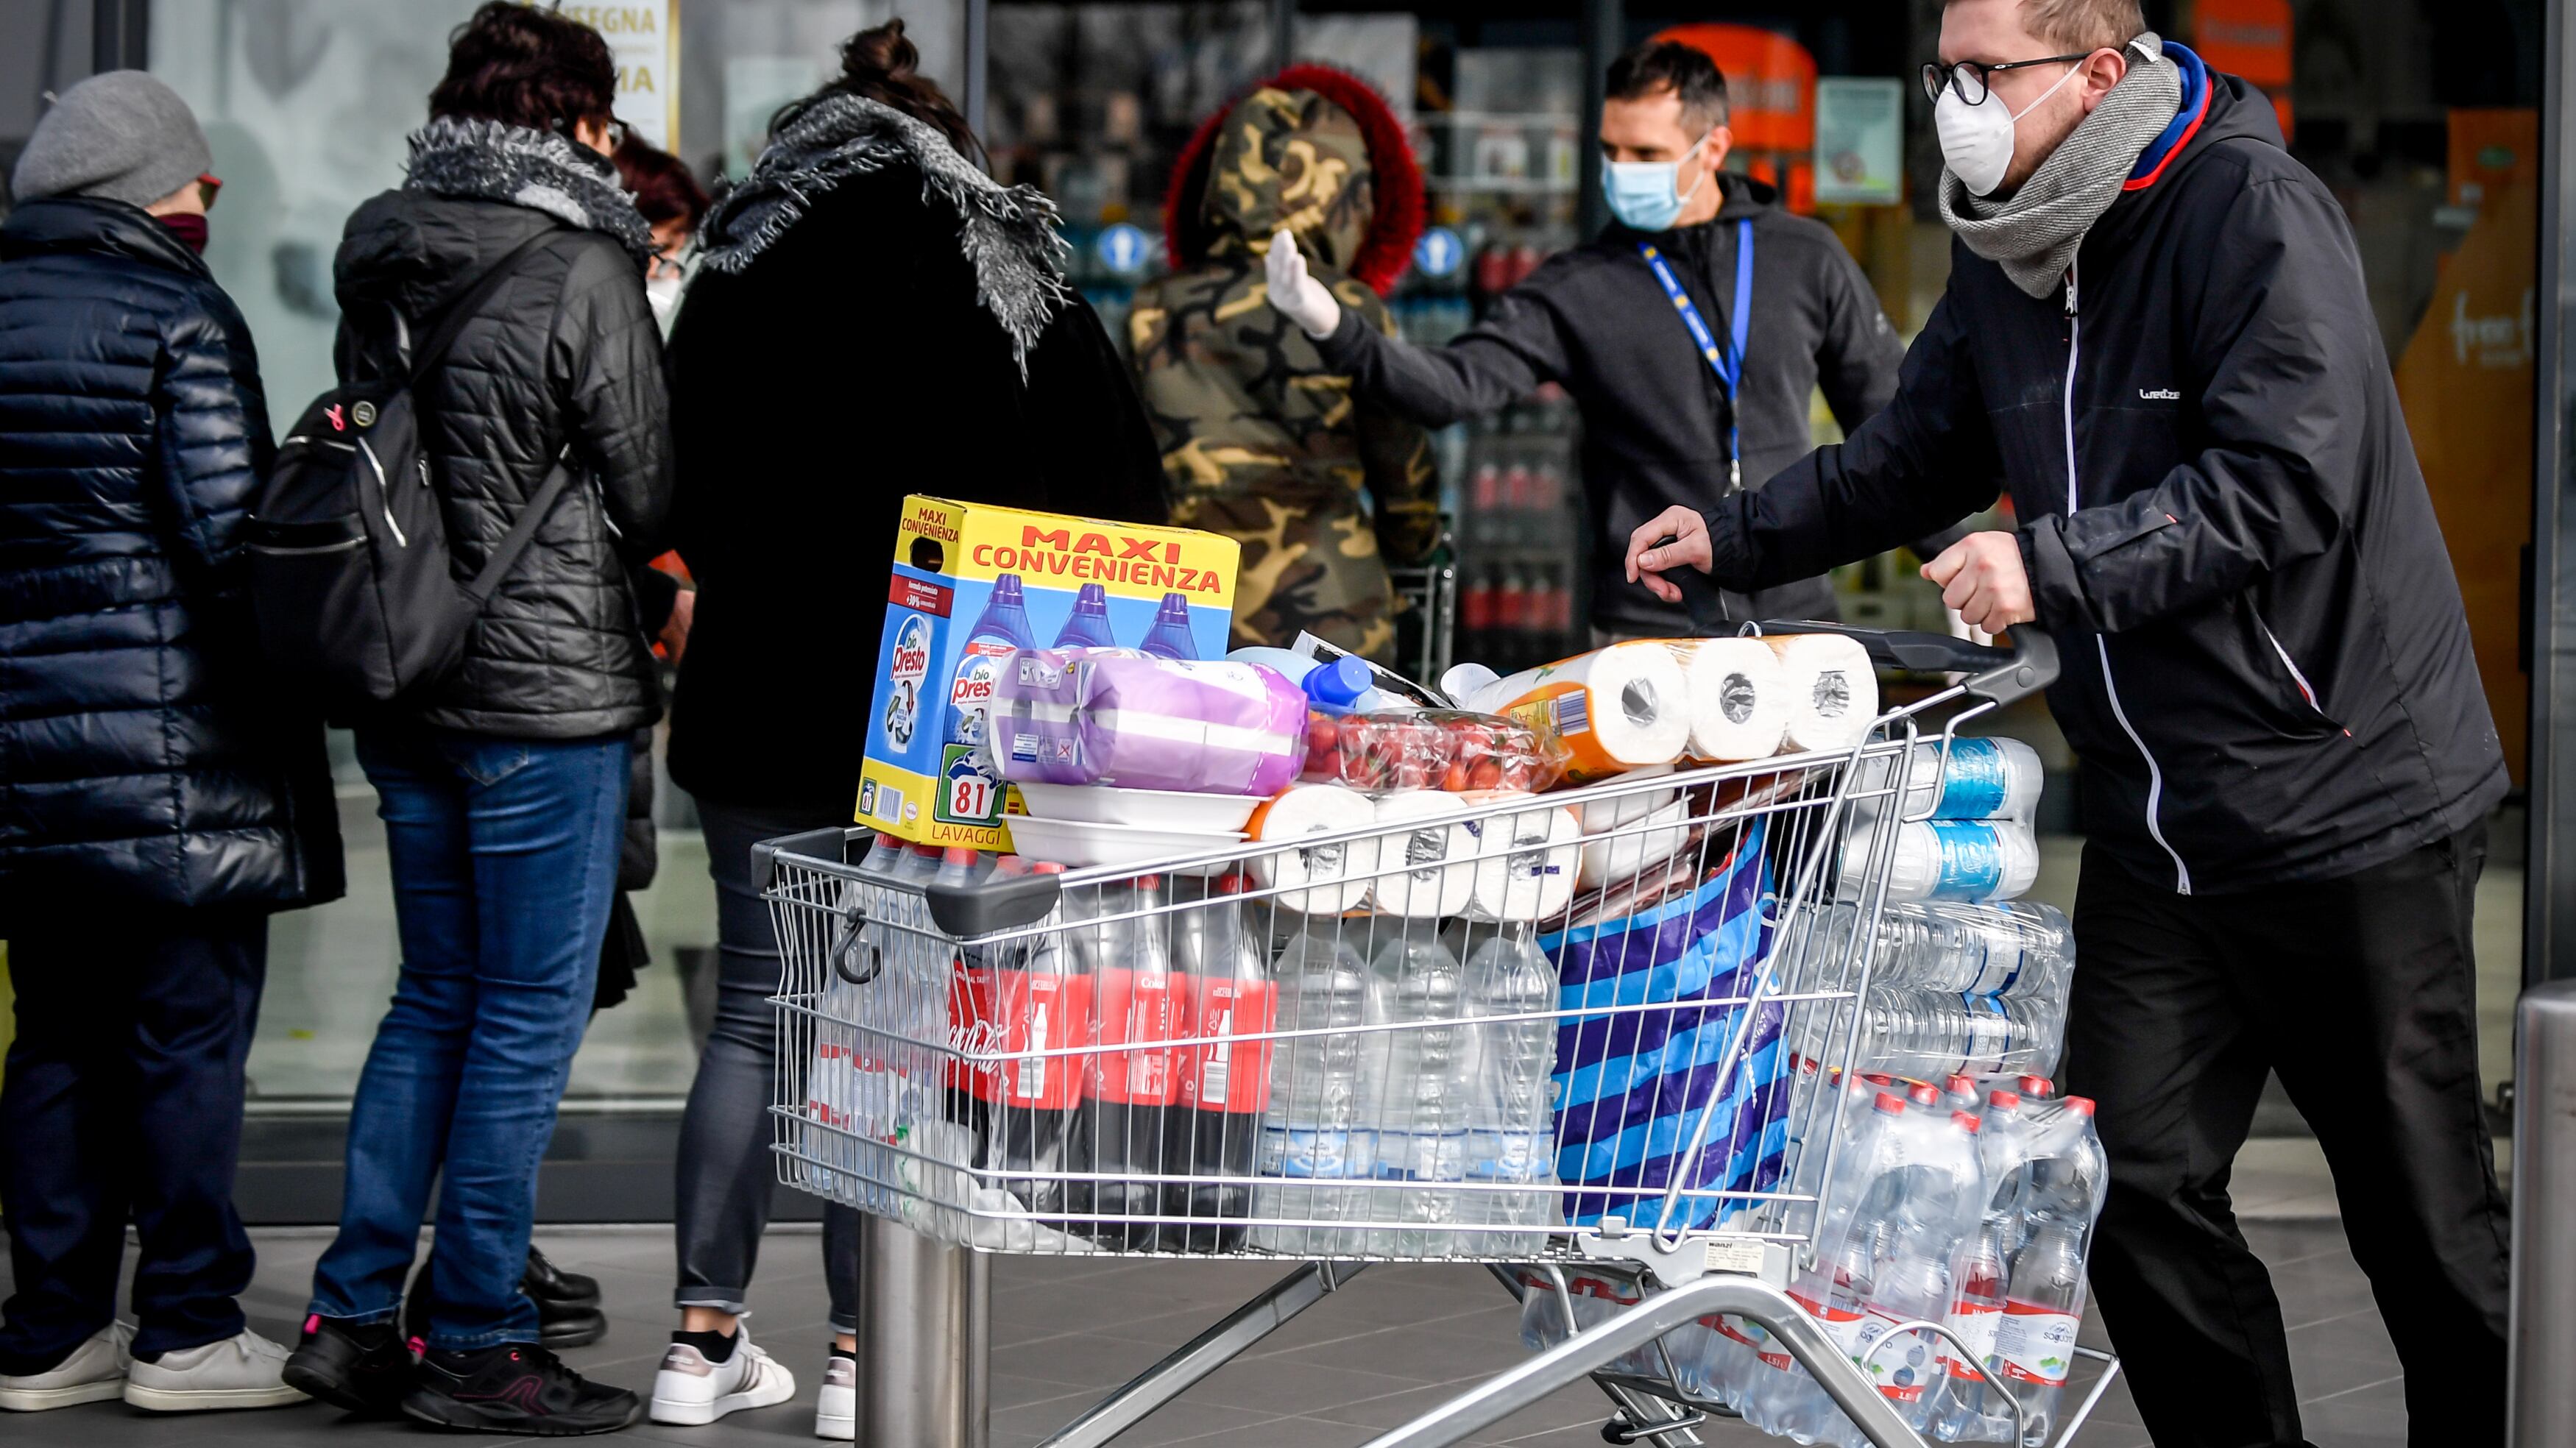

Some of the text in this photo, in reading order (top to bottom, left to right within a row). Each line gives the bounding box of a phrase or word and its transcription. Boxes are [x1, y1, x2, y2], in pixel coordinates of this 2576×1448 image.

[918, 507, 946, 525] MAXI
[902, 518, 959, 543] CONVENIENZA
[1022, 525, 1181, 564] MAXI
[973, 544, 1220, 593] CONVENIENZA
[906, 634, 916, 649] bio
[974, 668, 989, 681] bio
[863, 795, 871, 810] 81
[955, 781, 985, 815] 81
[932, 825, 1001, 845] LAVAGGI
[1141, 976, 1166, 990] Coke
